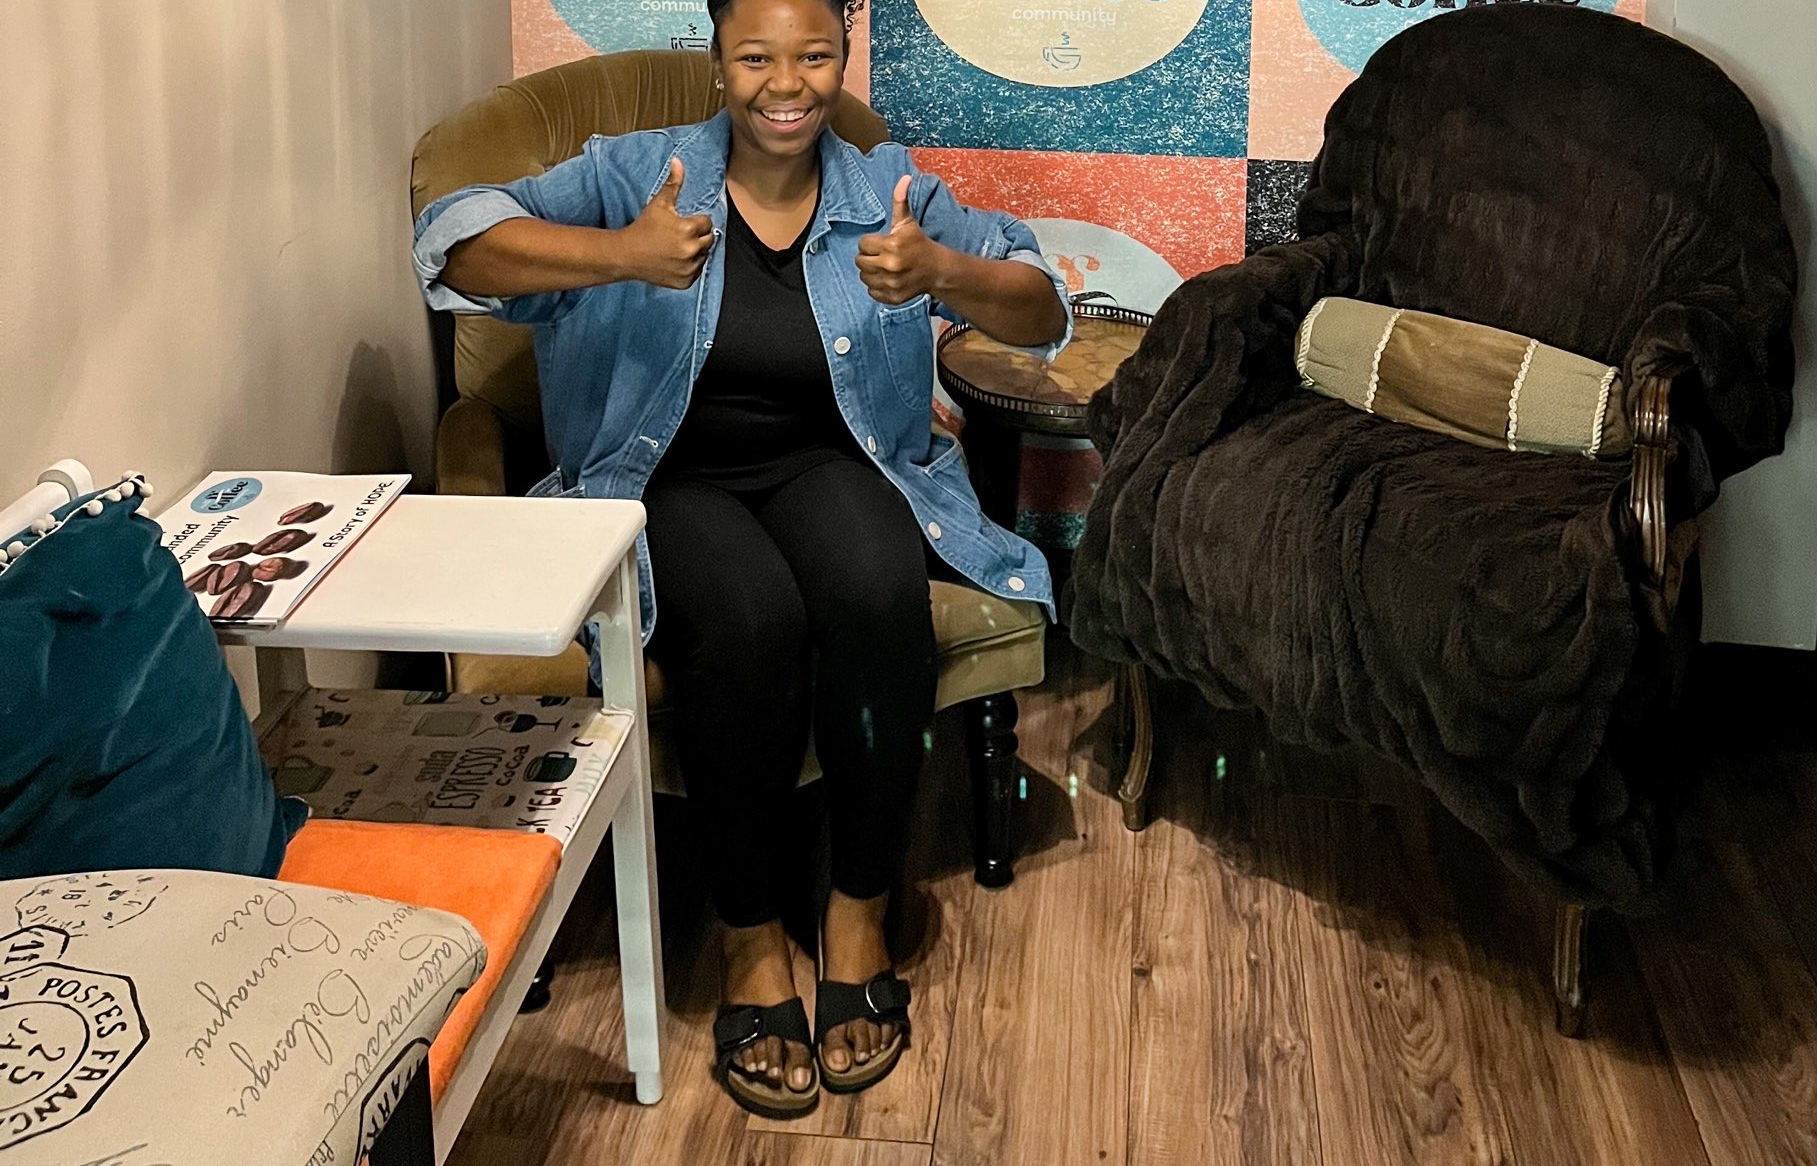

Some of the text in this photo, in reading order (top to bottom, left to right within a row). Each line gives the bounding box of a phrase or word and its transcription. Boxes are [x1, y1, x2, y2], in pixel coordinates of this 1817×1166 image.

[1012, 7, 1117, 26] community
[355, 507, 370, 516] of
[429, 746, 506, 809] ESPRESSO
[526, 786, 567, 811] TEA
[211, 886, 297, 946] Paris
[38, 977, 128, 1039] POSTES
[0, 1049, 121, 1135] FRANC
